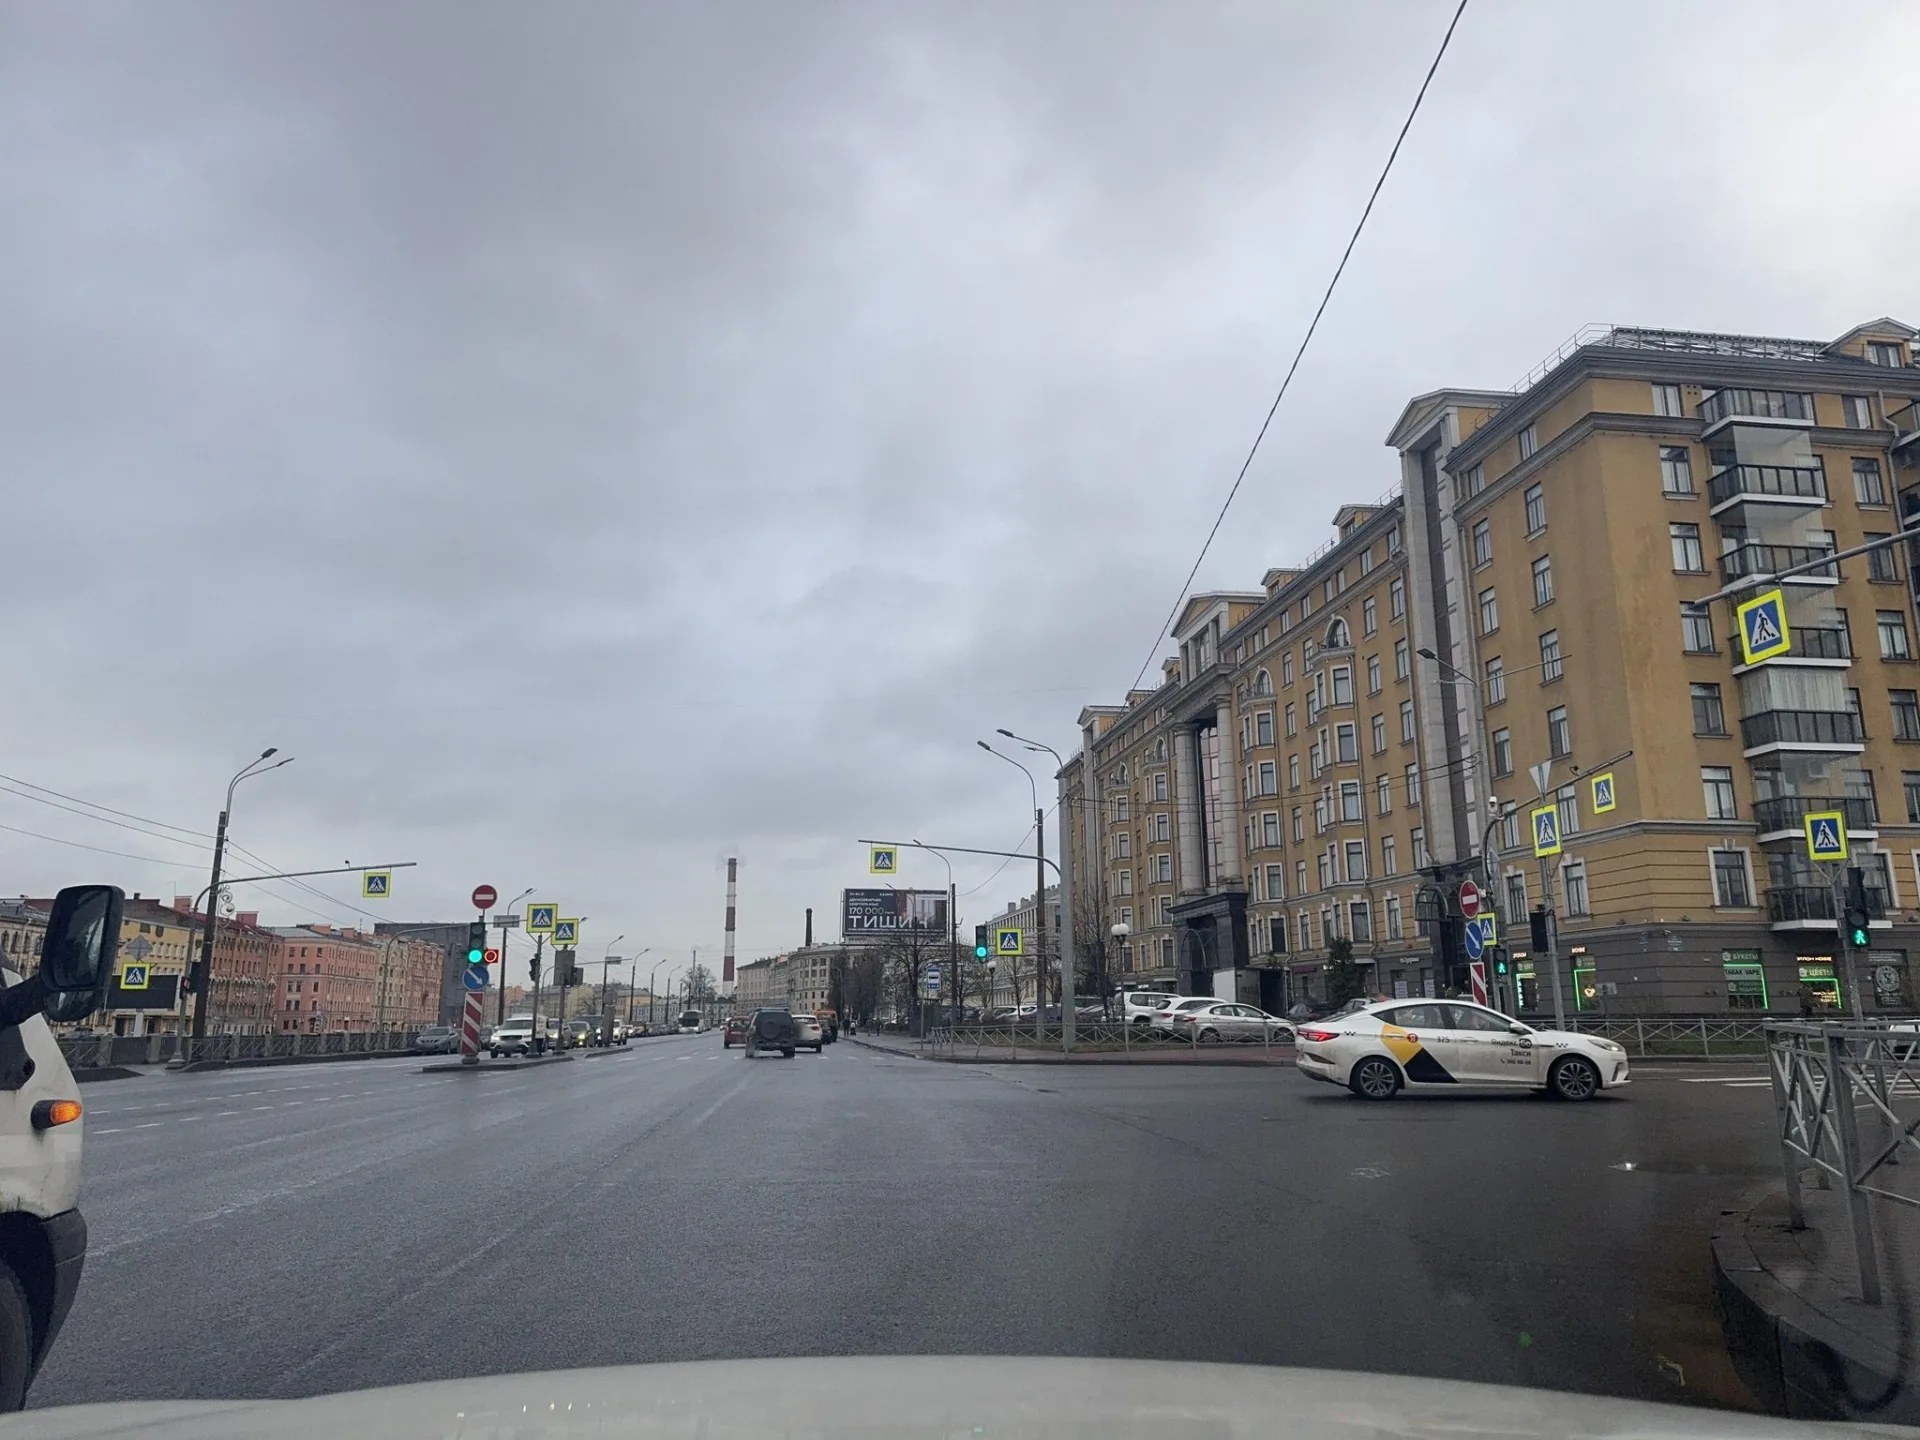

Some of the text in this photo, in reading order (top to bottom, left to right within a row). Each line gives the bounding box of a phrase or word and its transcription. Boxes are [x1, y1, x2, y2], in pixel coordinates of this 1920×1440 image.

[1810, 968, 1834, 976] ЦВЕТЫ
[1491, 1038, 1518, 1046] Яндекс
[1510, 1049, 1532, 1057] Такси
